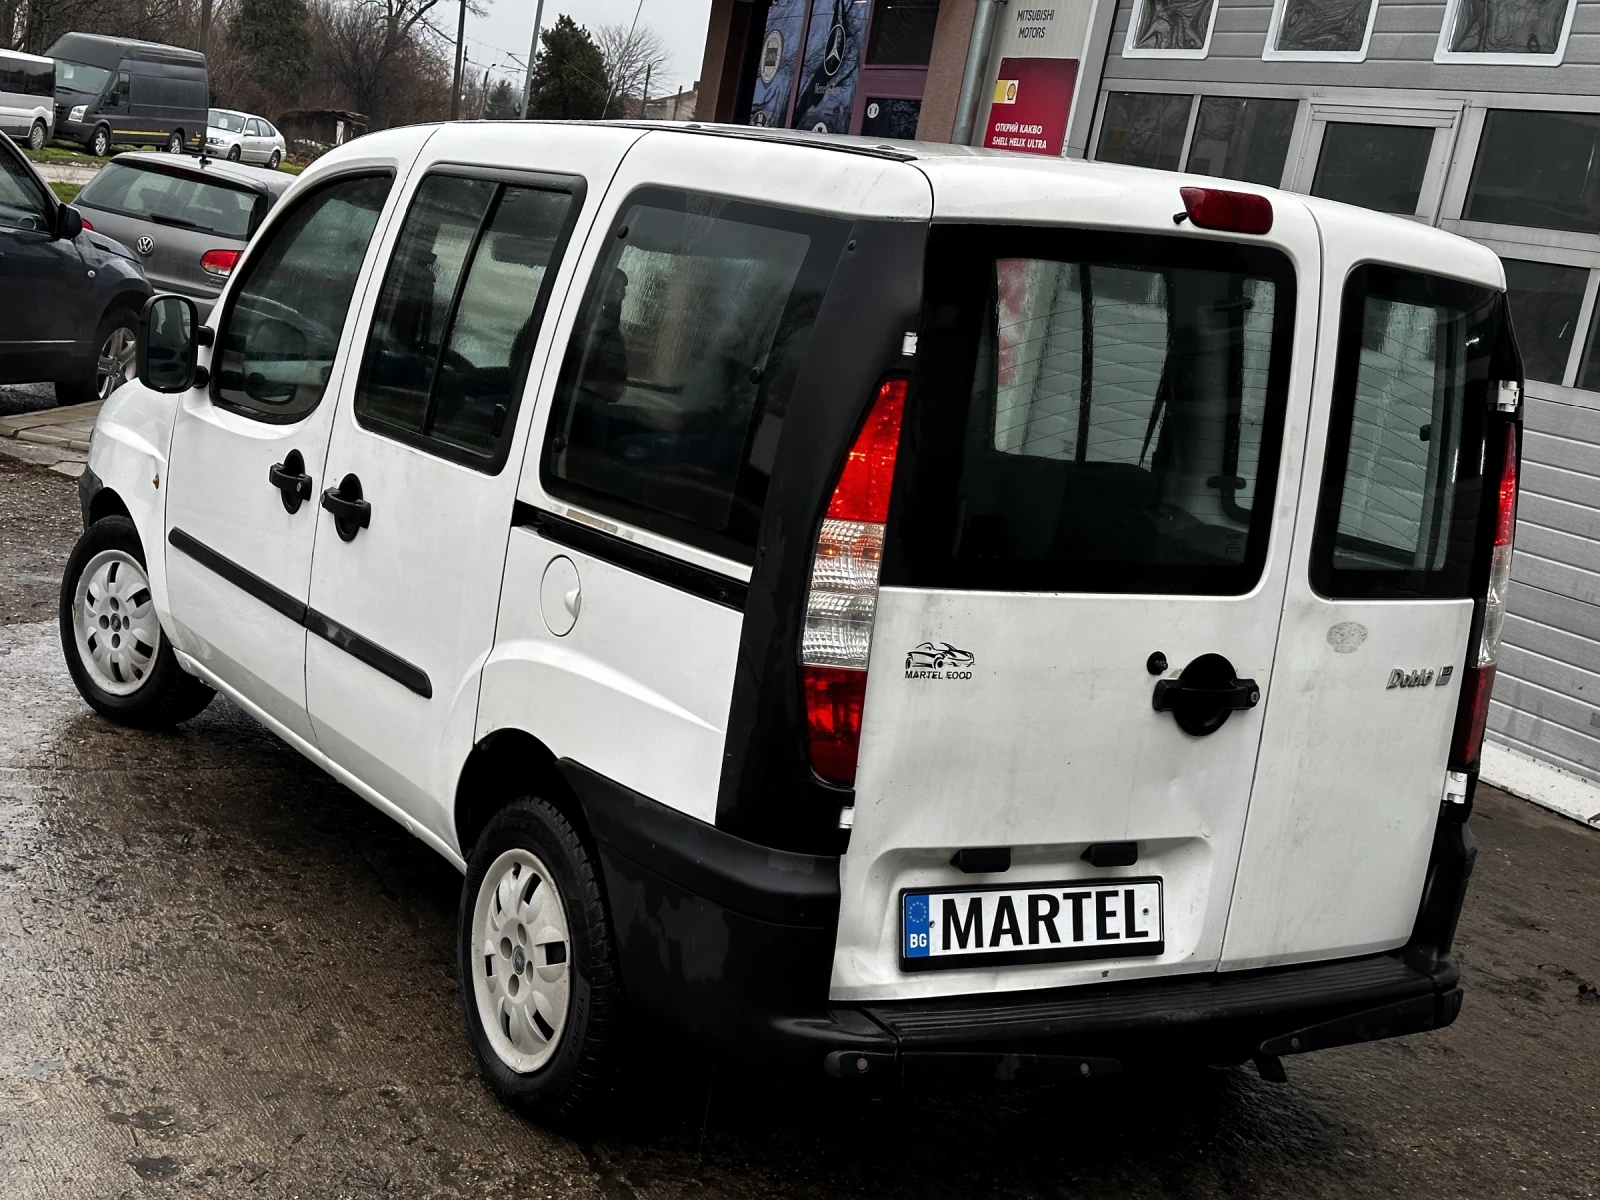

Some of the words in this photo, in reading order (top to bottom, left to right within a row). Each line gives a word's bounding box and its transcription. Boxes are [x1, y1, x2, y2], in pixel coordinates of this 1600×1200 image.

[1017, 9, 1055, 21] MITSUBISHI
[1018, 27, 1046, 38] MOTORS
[995, 121, 1019, 133] ОТКРИЙ
[1019, 124, 1043, 135] КАКВО
[992, 136, 1008, 146] SHELL
[1009, 137, 1027, 148] HELIX
[1027, 139, 1047, 150] ULTRA
[905, 671, 943, 680] MARTEL
[941, 888, 1149, 951] MARTEL
[909, 933, 927, 949] BG
